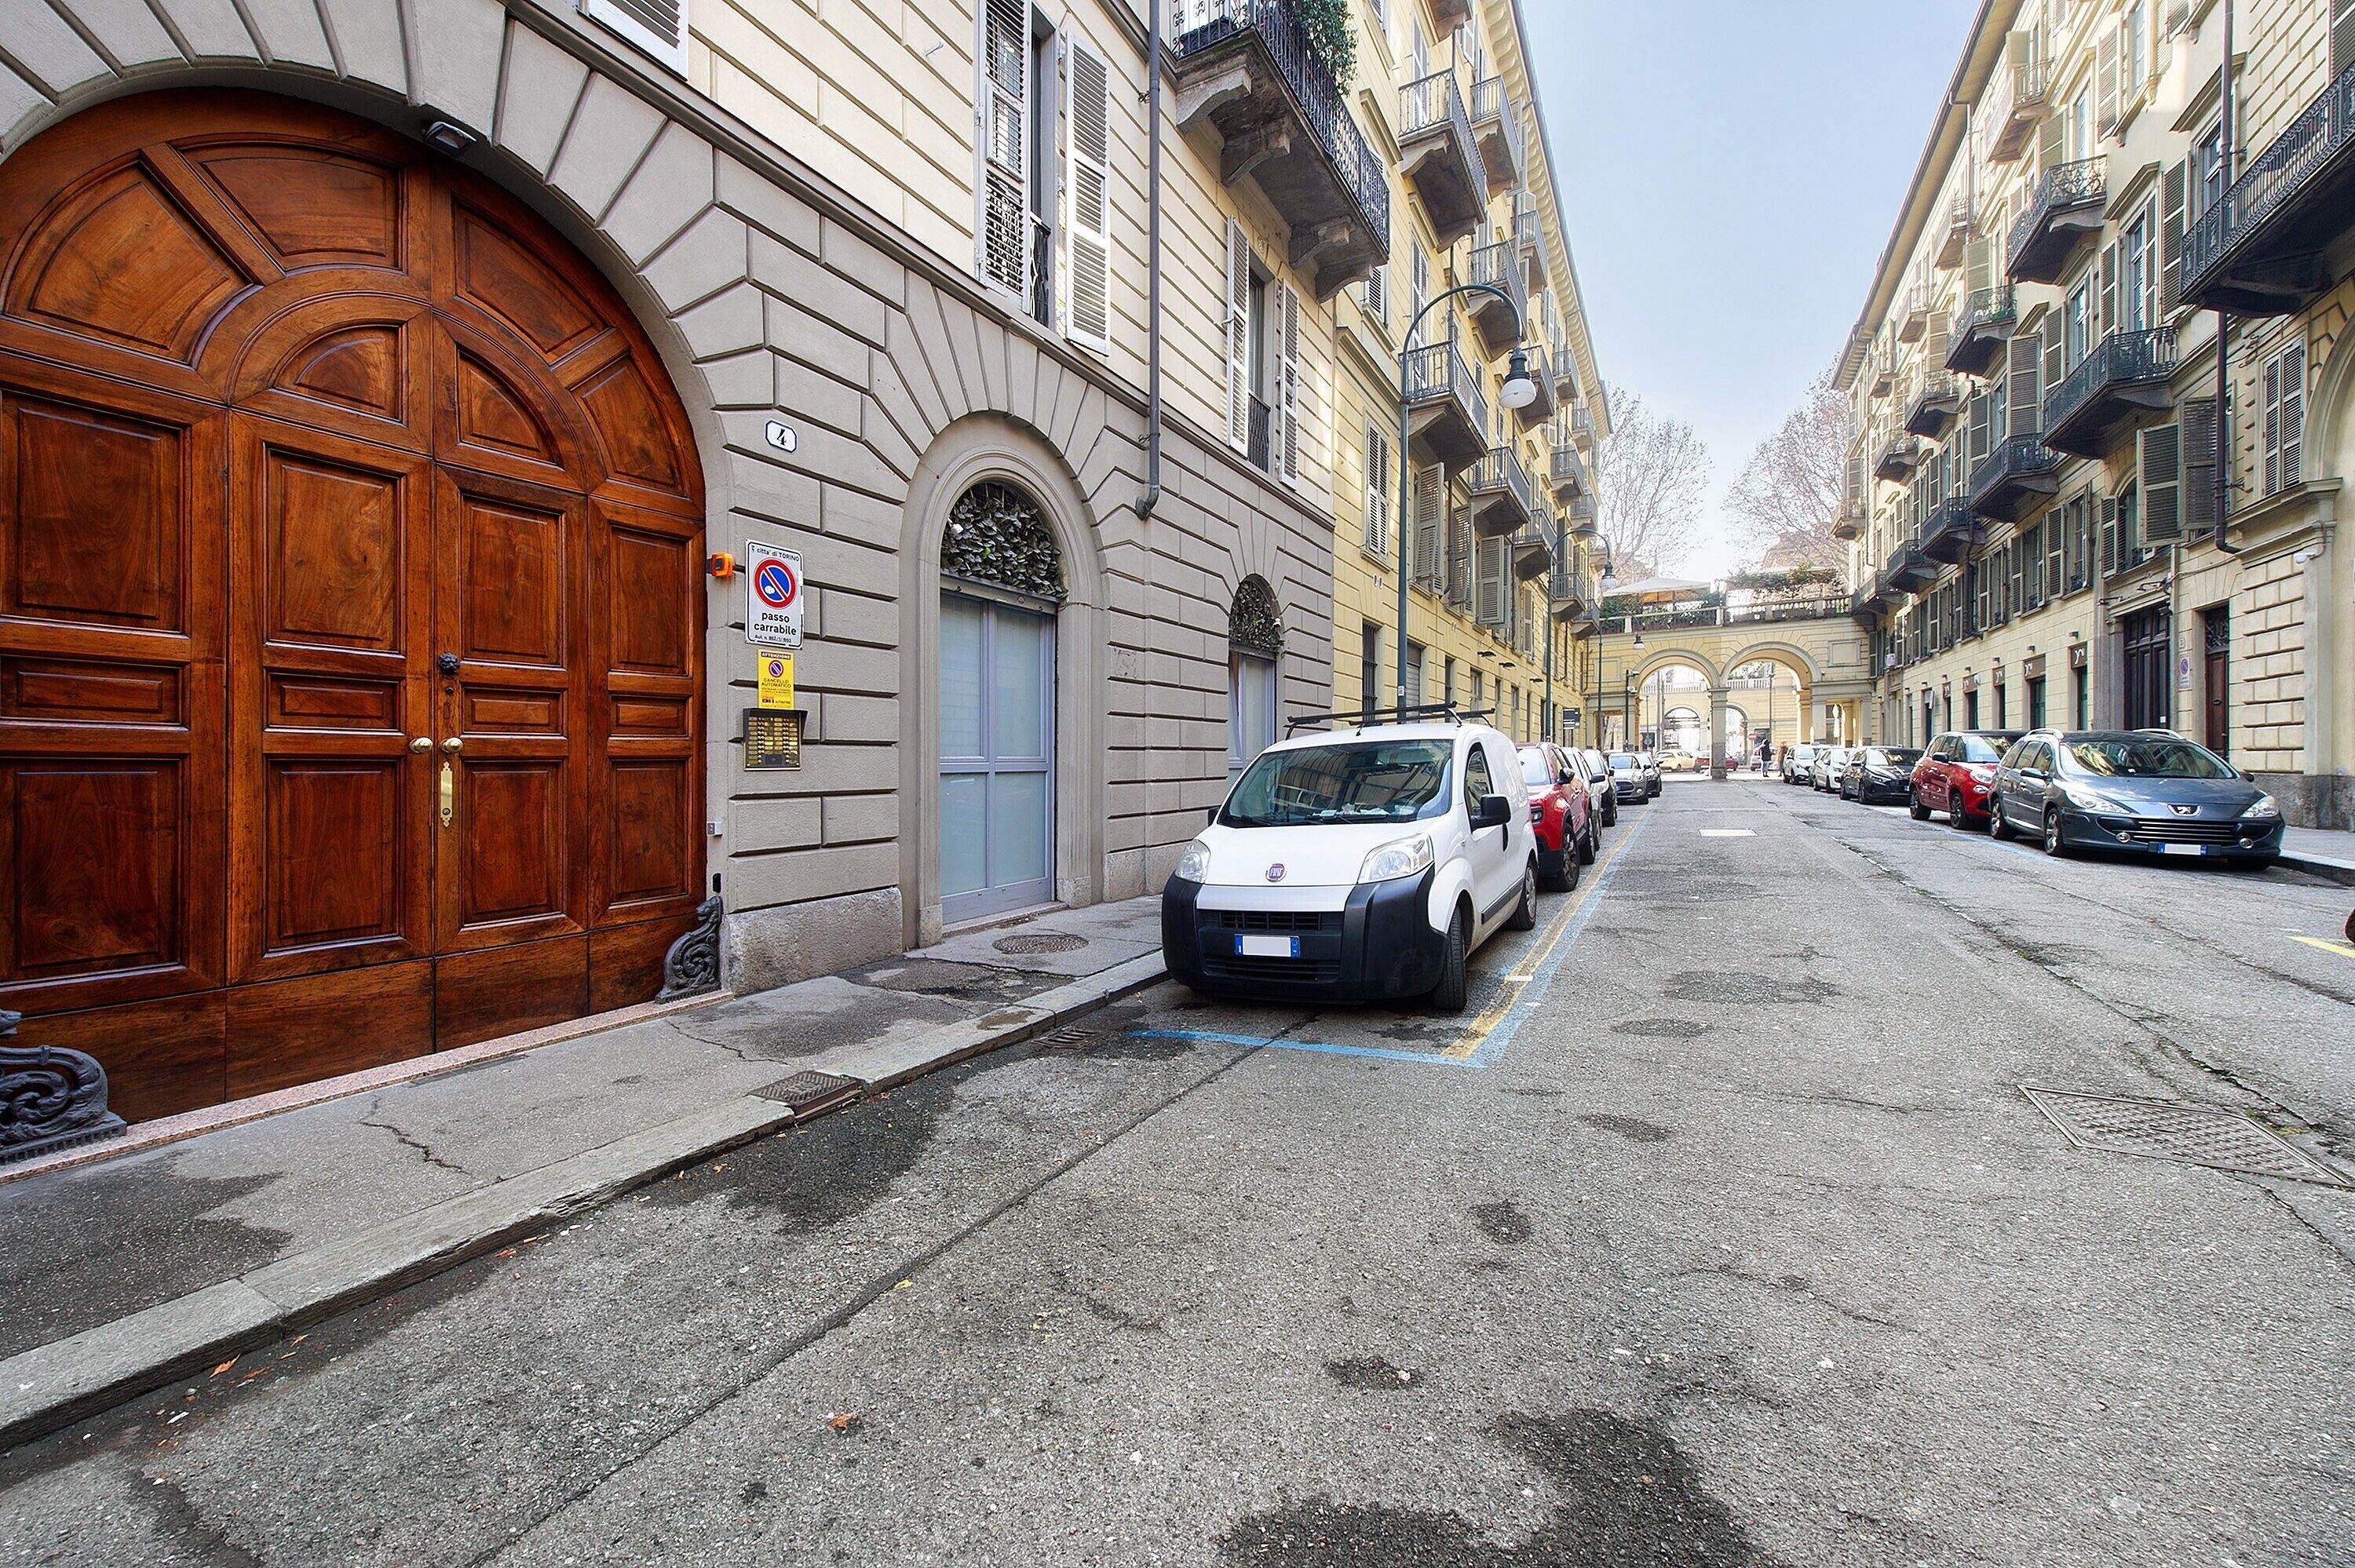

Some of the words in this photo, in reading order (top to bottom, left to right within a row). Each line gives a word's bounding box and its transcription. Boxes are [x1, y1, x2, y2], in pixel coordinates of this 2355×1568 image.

[776, 428, 787, 446] 4
[779, 552, 800, 562] TORINO
[761, 612, 790, 623] passo
[754, 623, 797, 636] carrabile
[1269, 867, 1284, 877] FIAT
